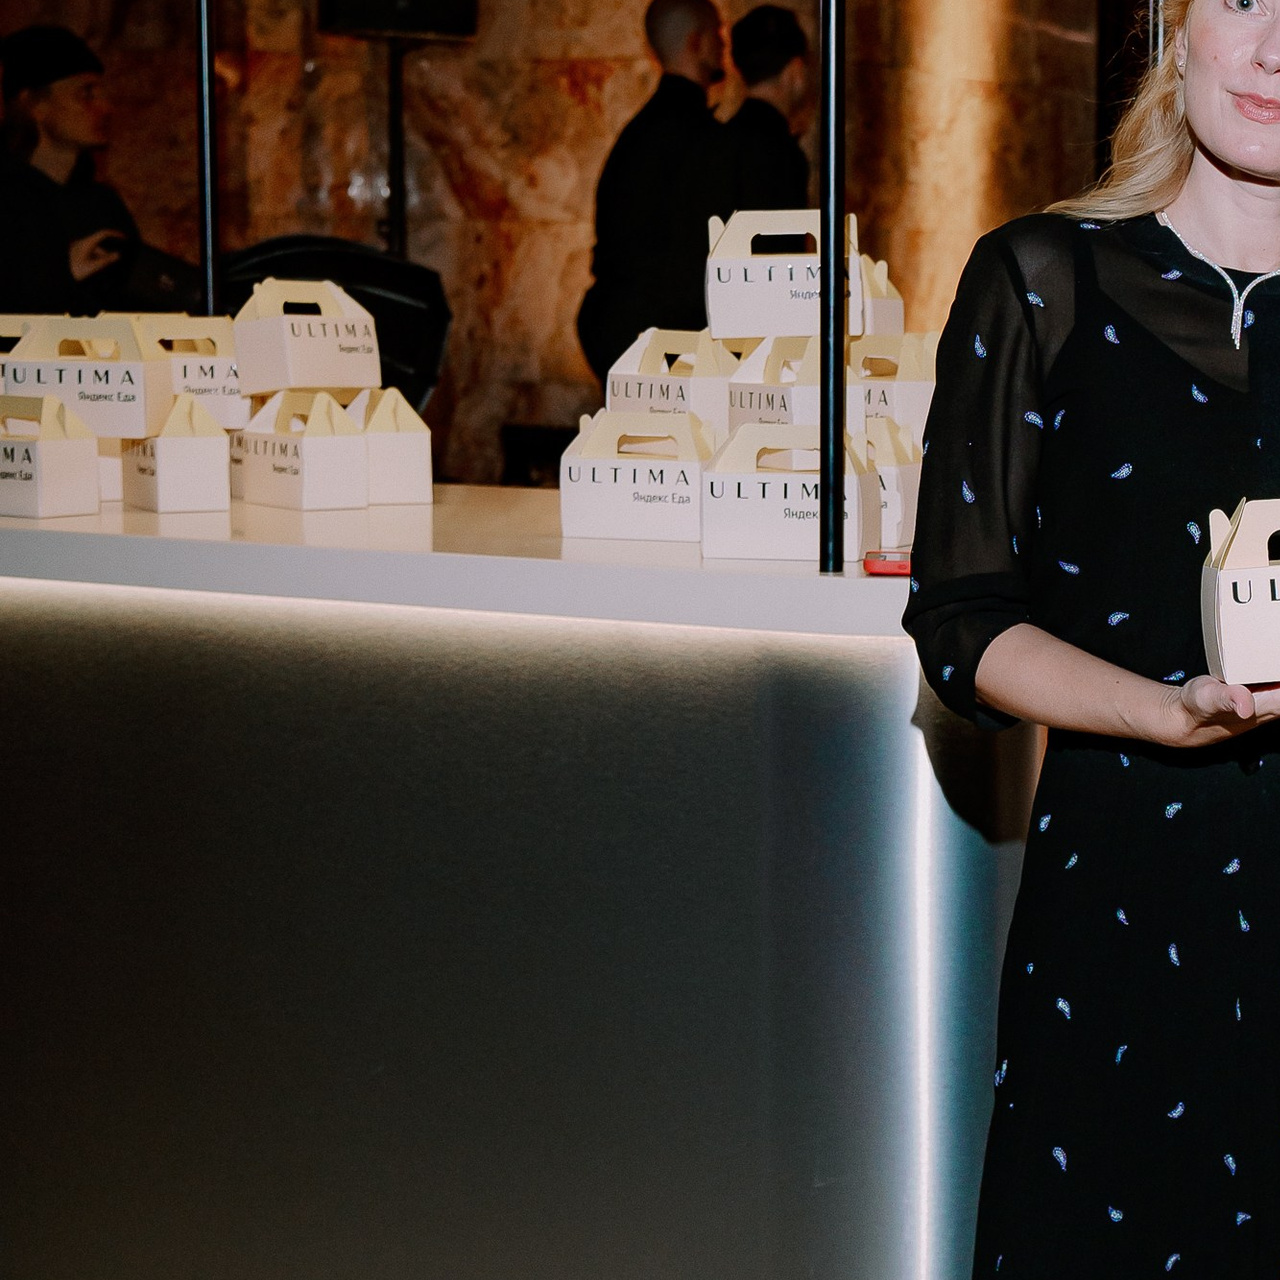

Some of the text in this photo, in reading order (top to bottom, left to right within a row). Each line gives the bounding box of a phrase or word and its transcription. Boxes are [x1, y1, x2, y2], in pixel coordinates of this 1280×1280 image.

[717, 265, 850, 283] ULTIM
[291, 322, 372, 337] ULTIMA
[12, 367, 135, 385] ULTIMA
[611, 380, 686, 402] ULTIMA
[729, 390, 788, 412] ULTIMA
[568, 466, 690, 486] ULTIMA
[632, 491, 691, 504] Яндекс Еда
[710, 481, 847, 500] ULTIM
[783, 507, 819, 520] Яндек
